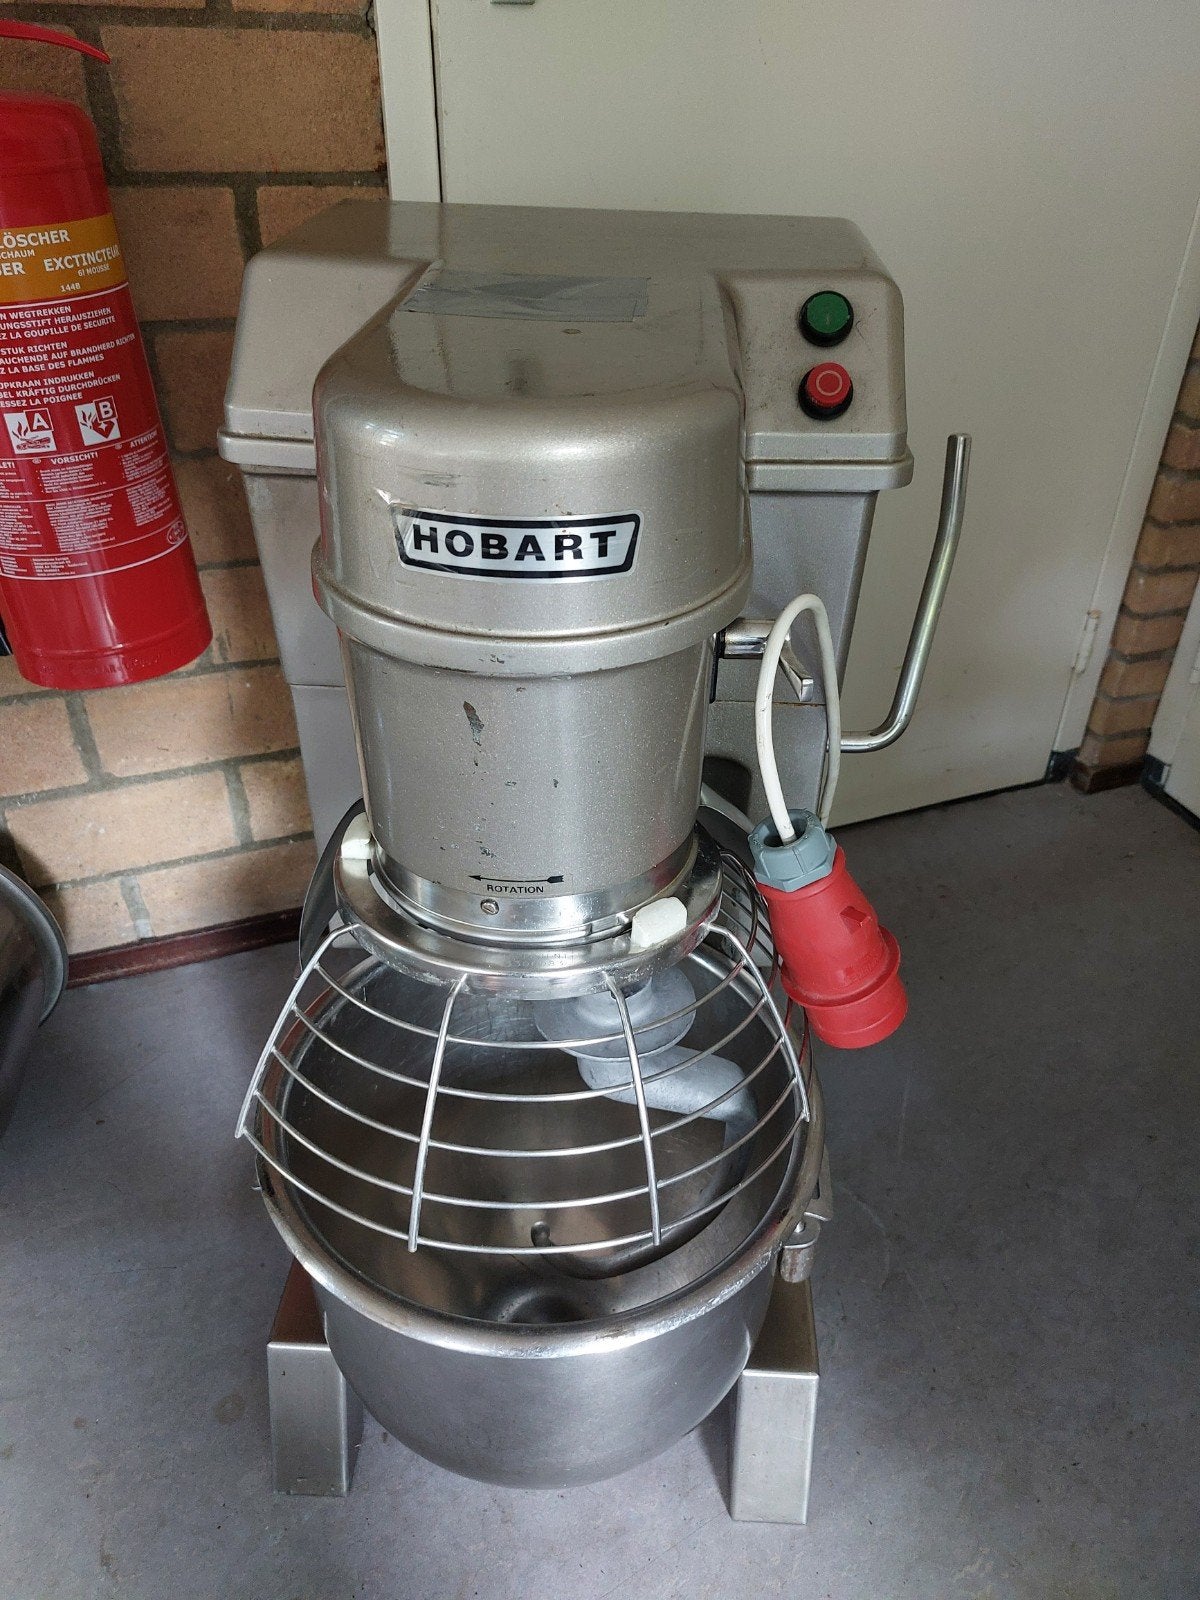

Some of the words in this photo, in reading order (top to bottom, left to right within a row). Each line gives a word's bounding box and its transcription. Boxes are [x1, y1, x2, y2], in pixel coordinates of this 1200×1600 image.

[0, 249, 35, 259] CHAUM
[0, 261, 26, 276] ER
[9, 306, 72, 320] WEGTREKKEN
[10, 331, 22, 340] LA
[24, 325, 69, 339] GOUPILLE
[70, 322, 82, 332] DE
[27, 341, 68, 353] RICHTEN
[51, 350, 68, 360] AUF
[70, 340, 115, 357] BRANDHERD
[8, 366, 21, 374] LA
[22, 364, 46, 373] BASE
[48, 361, 66, 370] DES
[68, 353, 105, 367] FLAMMES
[16, 387, 56, 398] KRÄFTIG
[58, 373, 121, 393] DURCHDRÜCKEN
[44, 370, 95, 386] INDRUKKEN
[29, 398, 41, 406] LA
[44, 392, 83, 405] POIGNEE
[98, 401, 114, 419] B
[32, 412, 49, 430] A
[413, 524, 616, 561] HOBART
[487, 884, 544, 894] ROTATION
